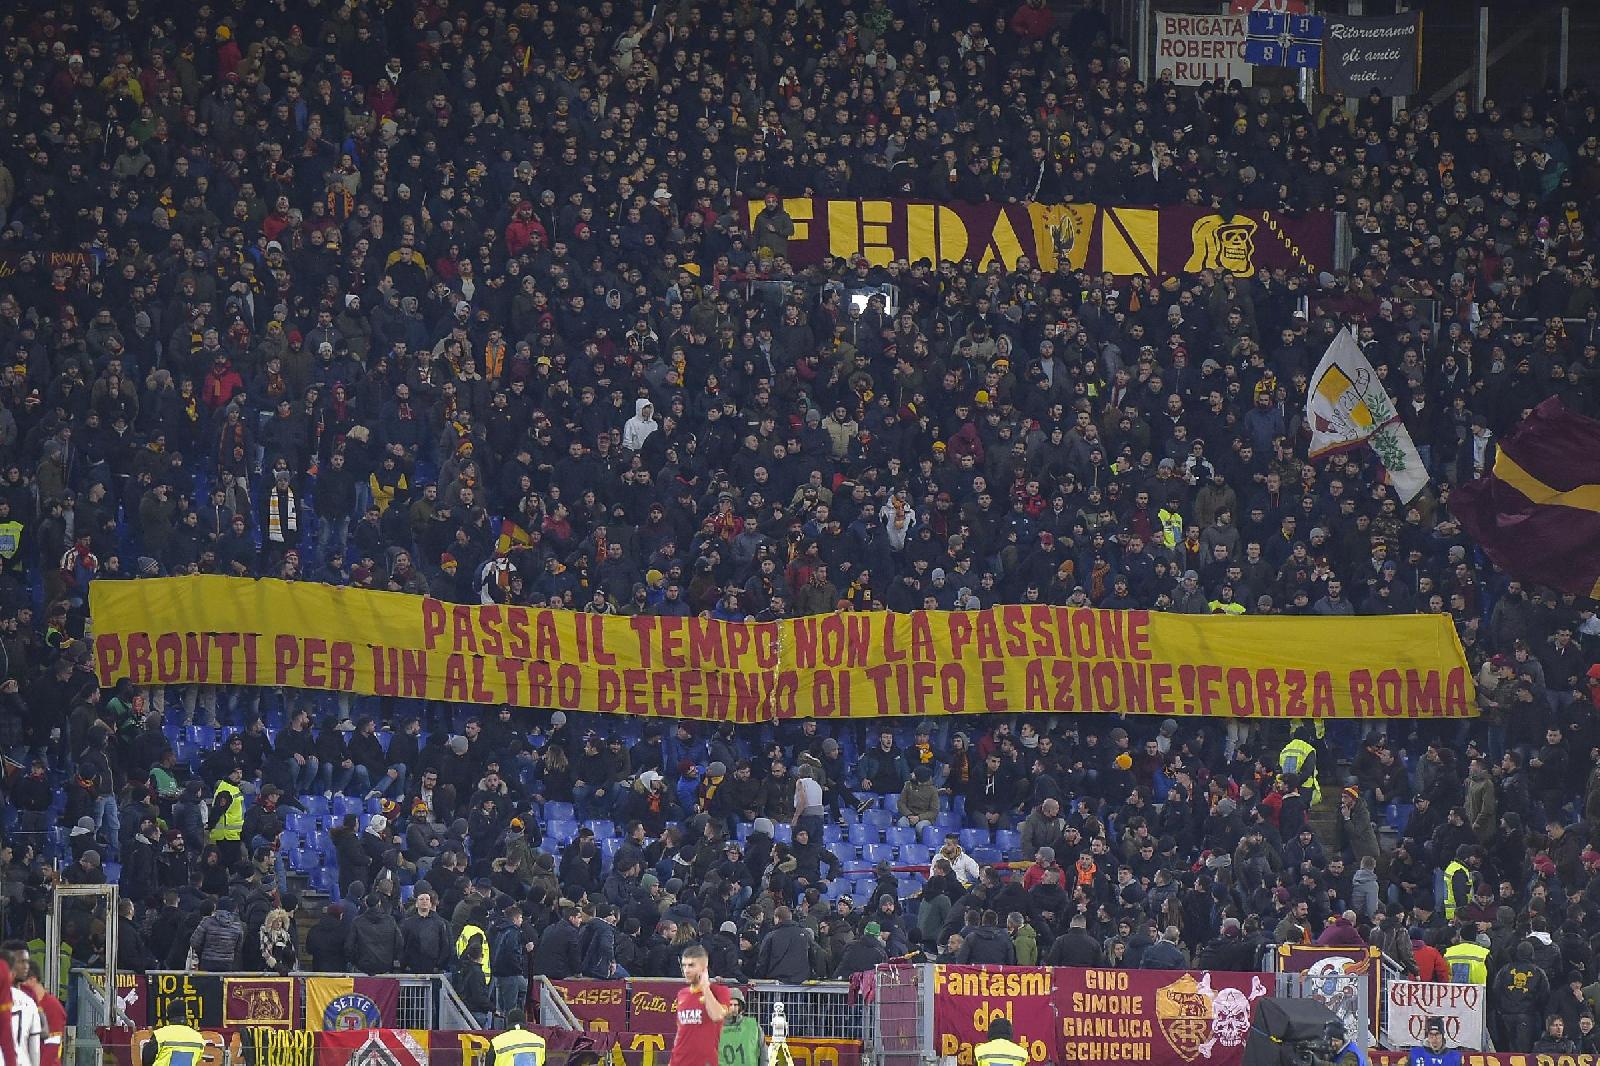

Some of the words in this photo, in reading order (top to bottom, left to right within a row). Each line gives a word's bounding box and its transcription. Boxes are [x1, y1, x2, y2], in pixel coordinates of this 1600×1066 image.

[1165, 18, 1244, 36] BRIGATA
[1330, 23, 1415, 39] Ritorneranno
[1161, 39, 1247, 59] ROBERTO
[1342, 47, 1361, 66] gli
[1364, 47, 1401, 61] amici
[1176, 62, 1231, 80] RULLI
[422, 597, 562, 662] PASSA
[575, 612, 617, 666] IL
[630, 614, 779, 669] TEMPO
[793, 614, 871, 669] NON
[883, 609, 937, 663] LA
[948, 603, 1153, 661] PASSIONE
[95, 631, 257, 686] PRONTI
[275, 633, 356, 691] PER
[371, 645, 427, 698] UN
[443, 653, 582, 709] ALTRO
[597, 668, 799, 723] DECENNIO
[812, 669, 851, 718] DI
[865, 660, 967, 714] TIFO
[982, 660, 1009, 712] E
[1349, 666, 1469, 718] ROMA
[934, 964, 1052, 997] Fantasmi
[1085, 969, 1129, 991] GINO
[333, 996, 370, 1012] SETTE
[1072, 992, 1143, 1014] SIMONE
[1391, 983, 1479, 1014] GRUPPO
[973, 1001, 1013, 1032] del
[1063, 1017, 1153, 1038] GIANLUCA
[722, 1043, 746, 1065] 01
[1065, 1041, 1151, 1061] SCHICCHI
